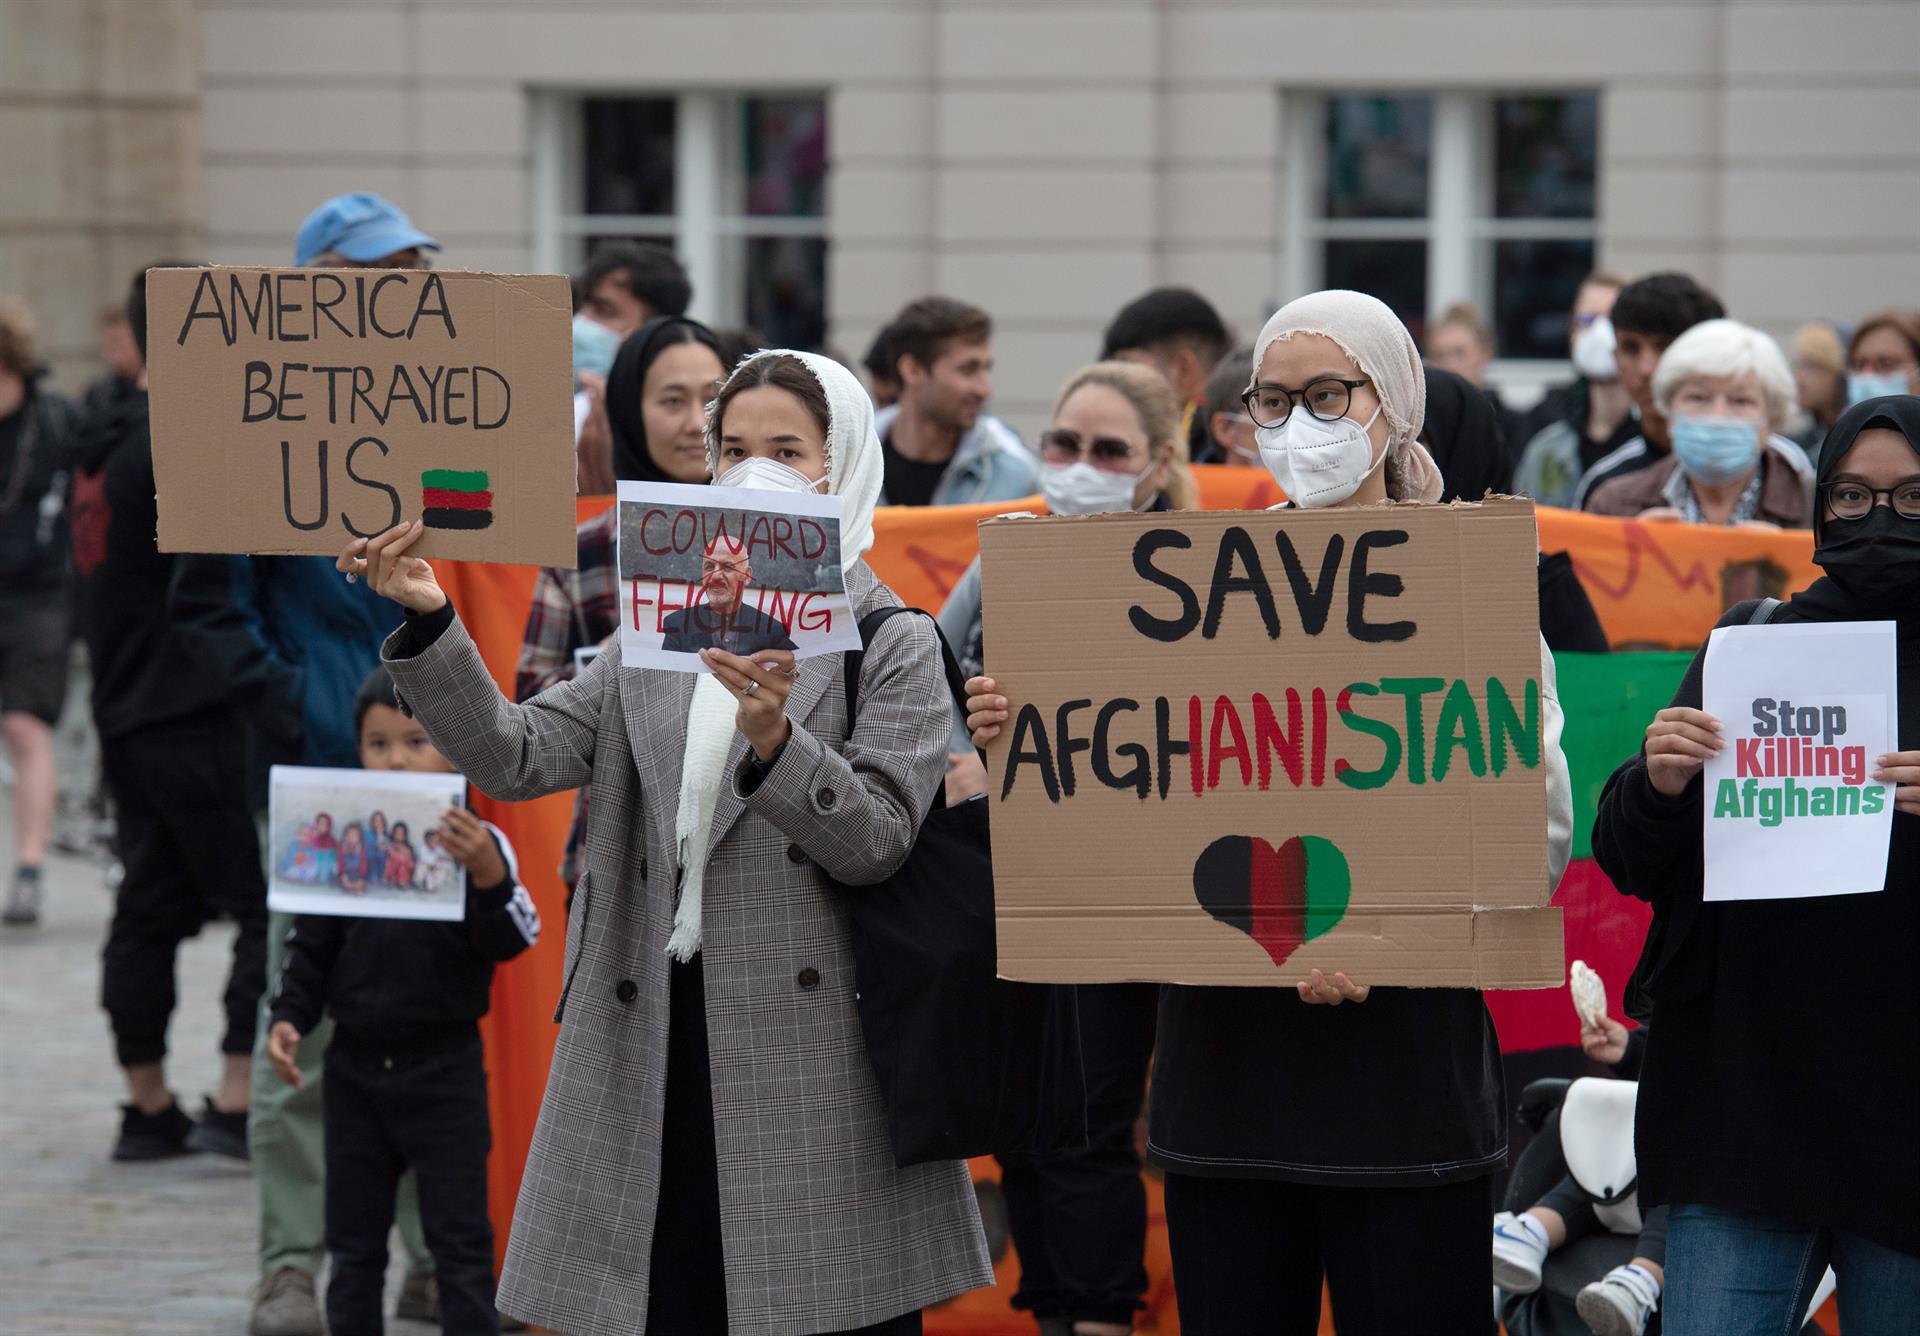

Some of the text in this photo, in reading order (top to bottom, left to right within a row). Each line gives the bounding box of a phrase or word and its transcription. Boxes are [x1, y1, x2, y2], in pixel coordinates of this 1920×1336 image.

[177, 271, 457, 346] AMERICA
[242, 361, 511, 430] BETRAYED
[280, 437, 402, 540] US
[640, 509, 827, 561] COWARD
[631, 574, 833, 640] FEIGLING
[1127, 526, 1418, 643] SAVE
[1000, 676, 1541, 803] AFGHANISTAN
[1751, 697, 1847, 745] Stop
[1735, 737, 1866, 785] Killing
[1713, 777, 1886, 827] Afghans
